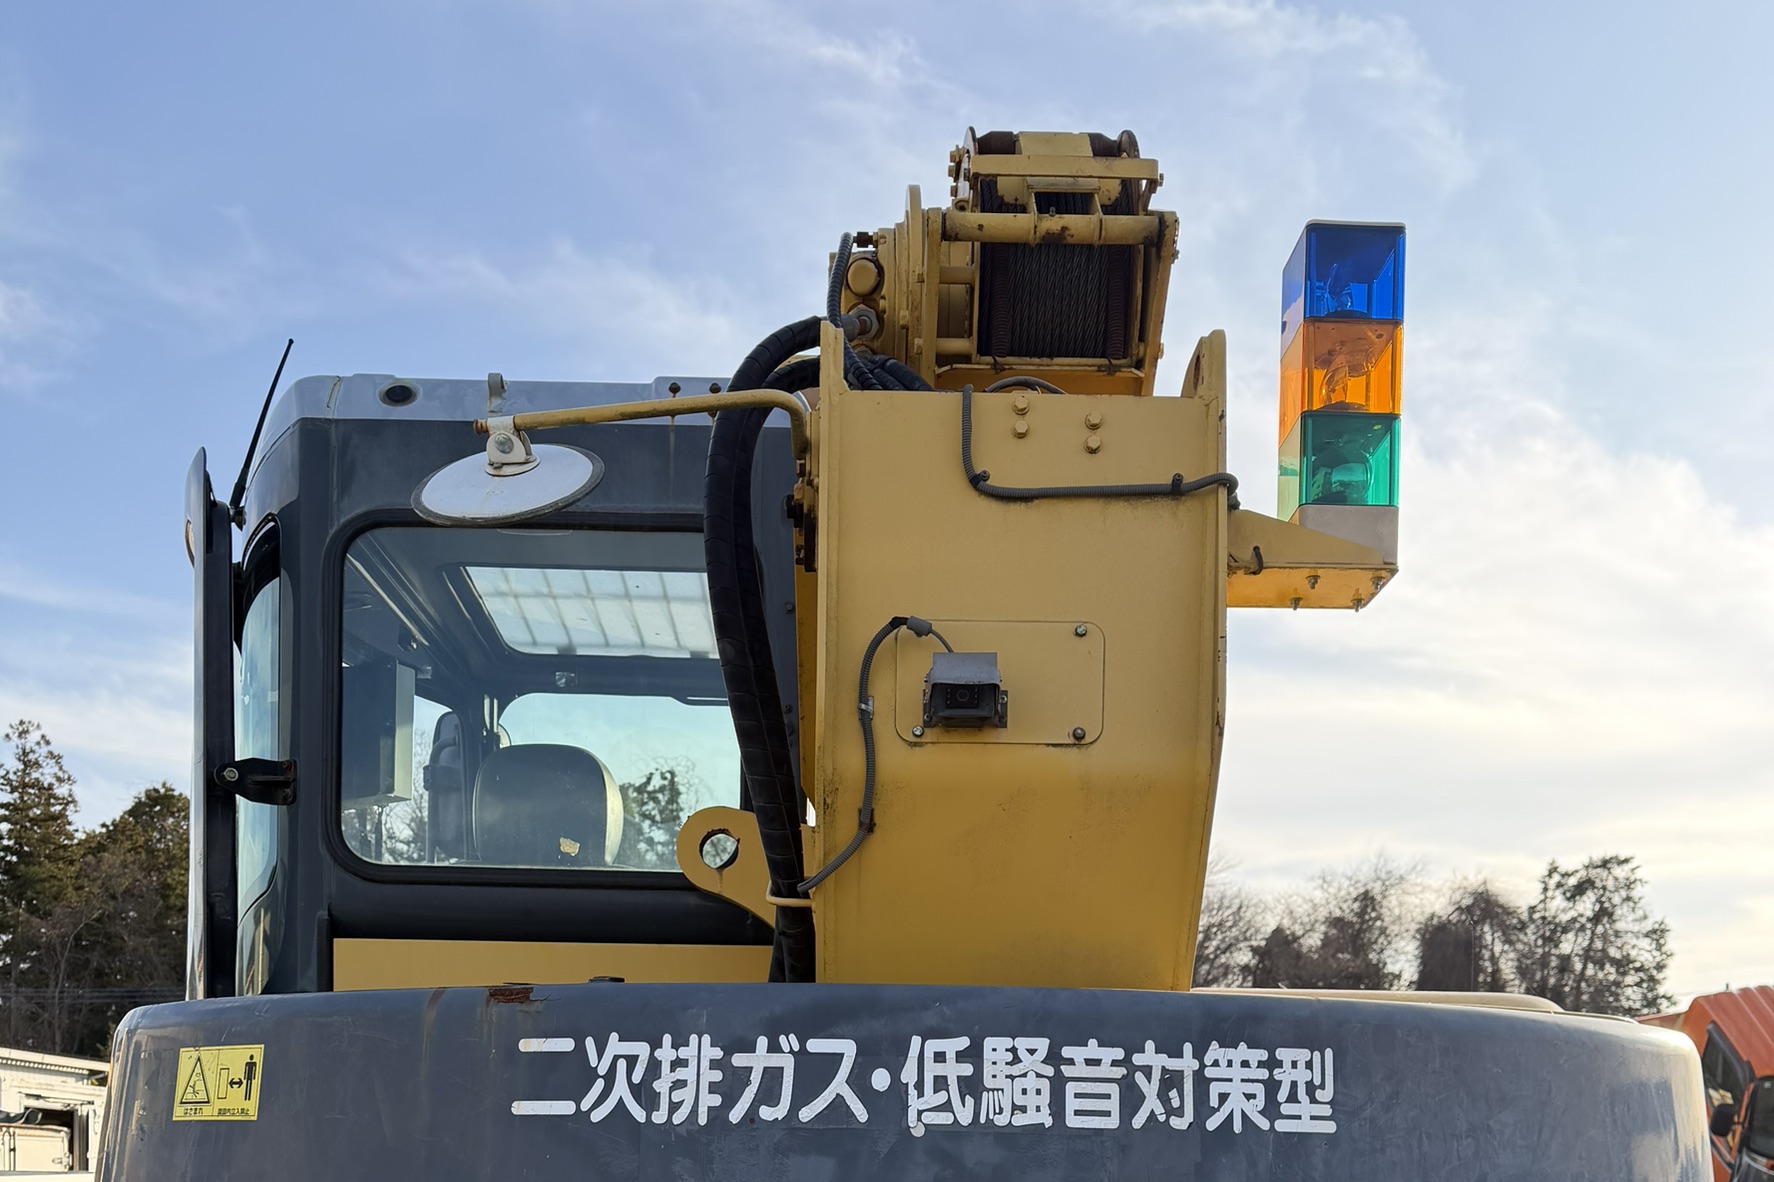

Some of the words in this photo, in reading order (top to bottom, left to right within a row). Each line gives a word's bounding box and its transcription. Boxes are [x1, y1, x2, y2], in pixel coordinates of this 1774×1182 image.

[511, 1032, 1337, 1134] 二次排ガス・低騒音対策型
